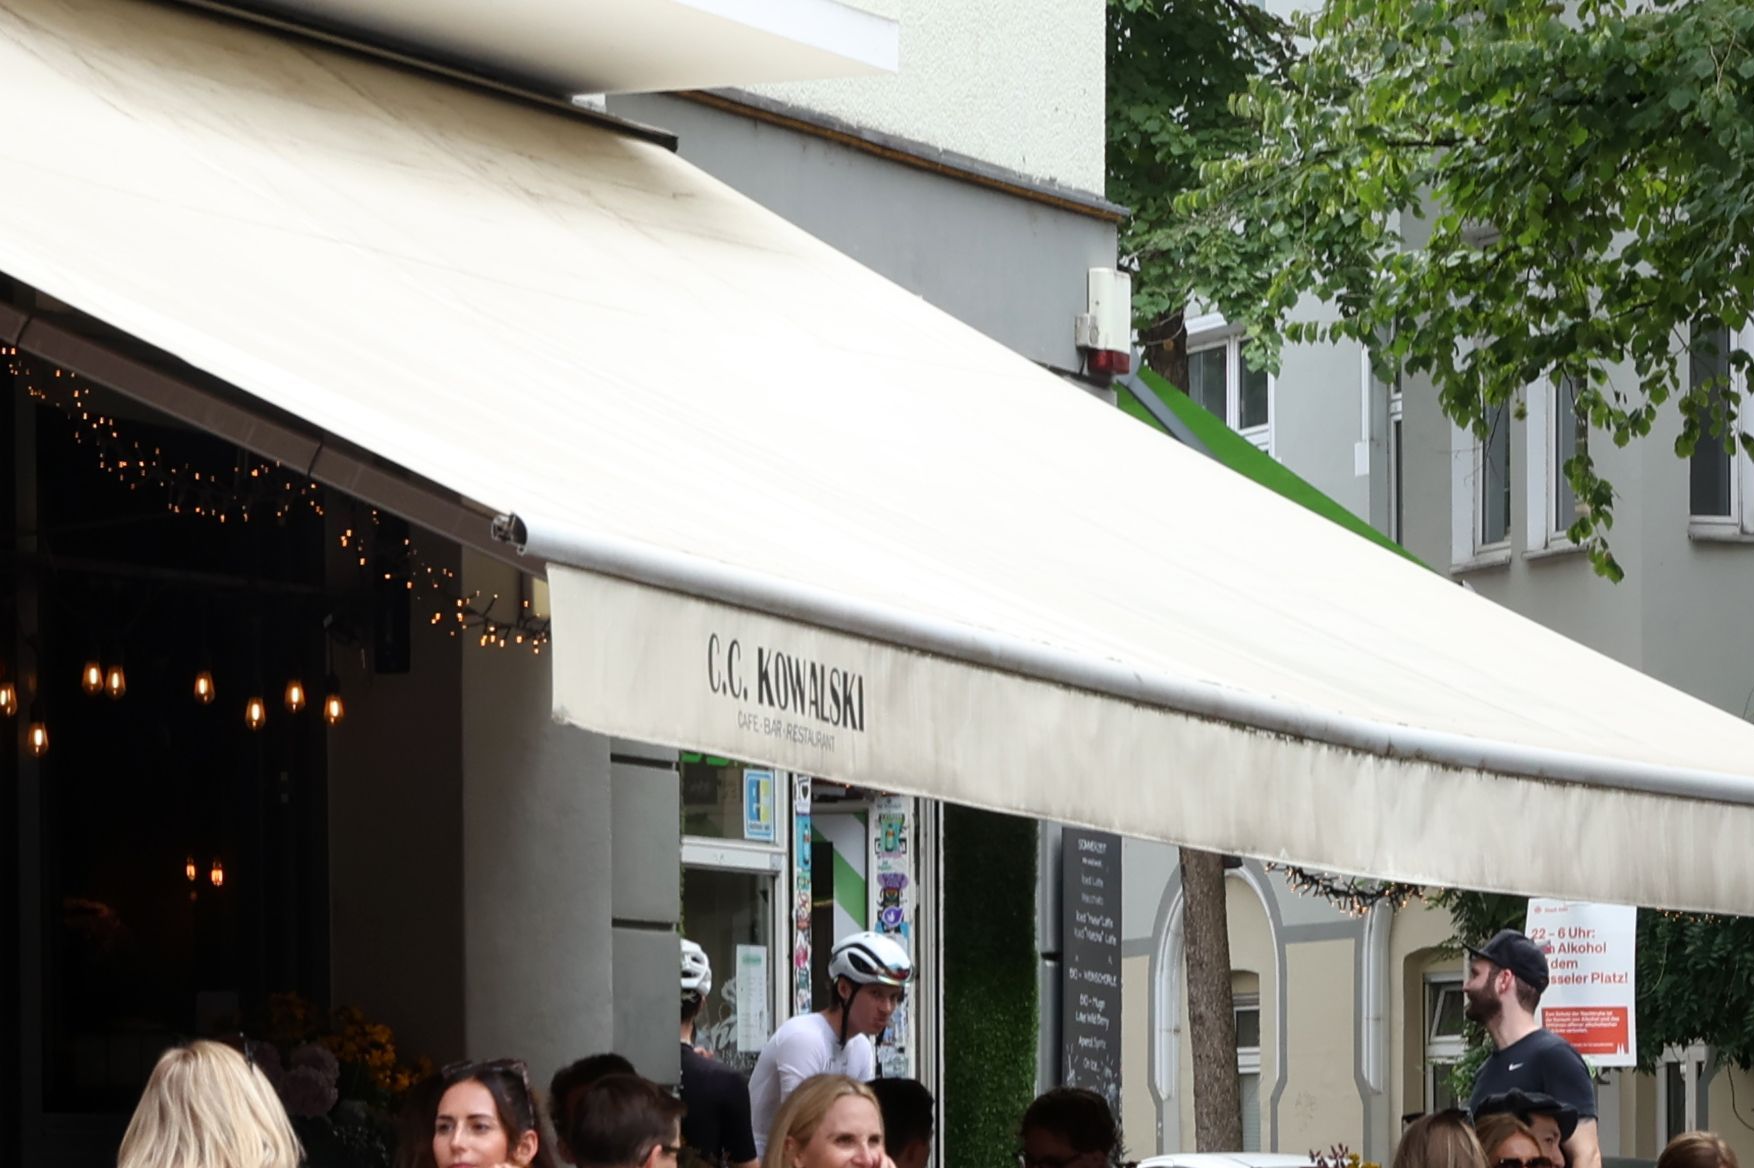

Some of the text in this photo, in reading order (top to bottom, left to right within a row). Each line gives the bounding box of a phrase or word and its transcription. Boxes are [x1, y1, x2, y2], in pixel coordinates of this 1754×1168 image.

[708, 632, 865, 732] C.C. KOWALSKI
[1531, 928, 1546, 940] 22
[1558, 928, 1566, 939] 6
[1569, 926, 1596, 939] Uhr:
[1558, 942, 1607, 954] Alkohol
[1551, 958, 1578, 969] dem
[1550, 972, 1628, 984] sseler Platz!
